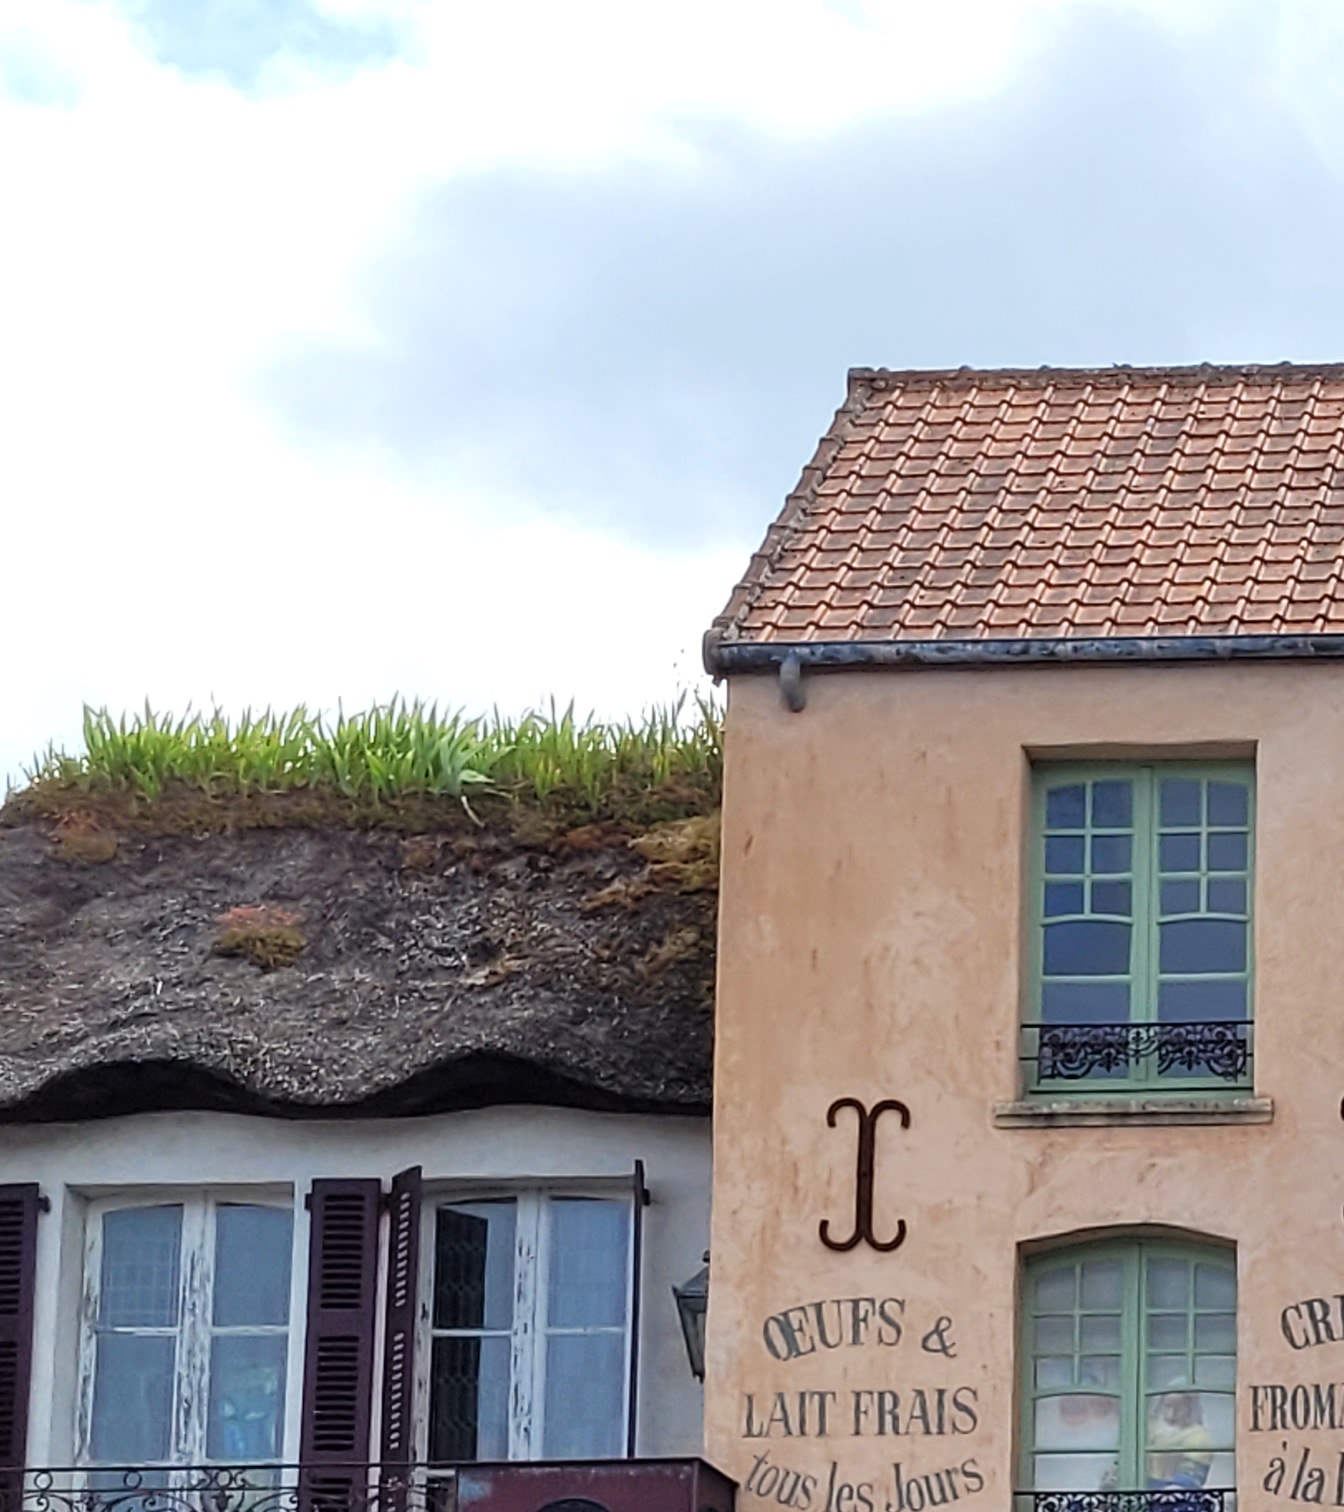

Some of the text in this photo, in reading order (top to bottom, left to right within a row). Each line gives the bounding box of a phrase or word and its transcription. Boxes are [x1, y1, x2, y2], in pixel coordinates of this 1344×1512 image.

[921, 1316, 957, 1358] &
[742, 1386, 979, 1438] LAIT FRAIS
[745, 1448, 818, 1511] tous
[1290, 1447, 1326, 1504] la
